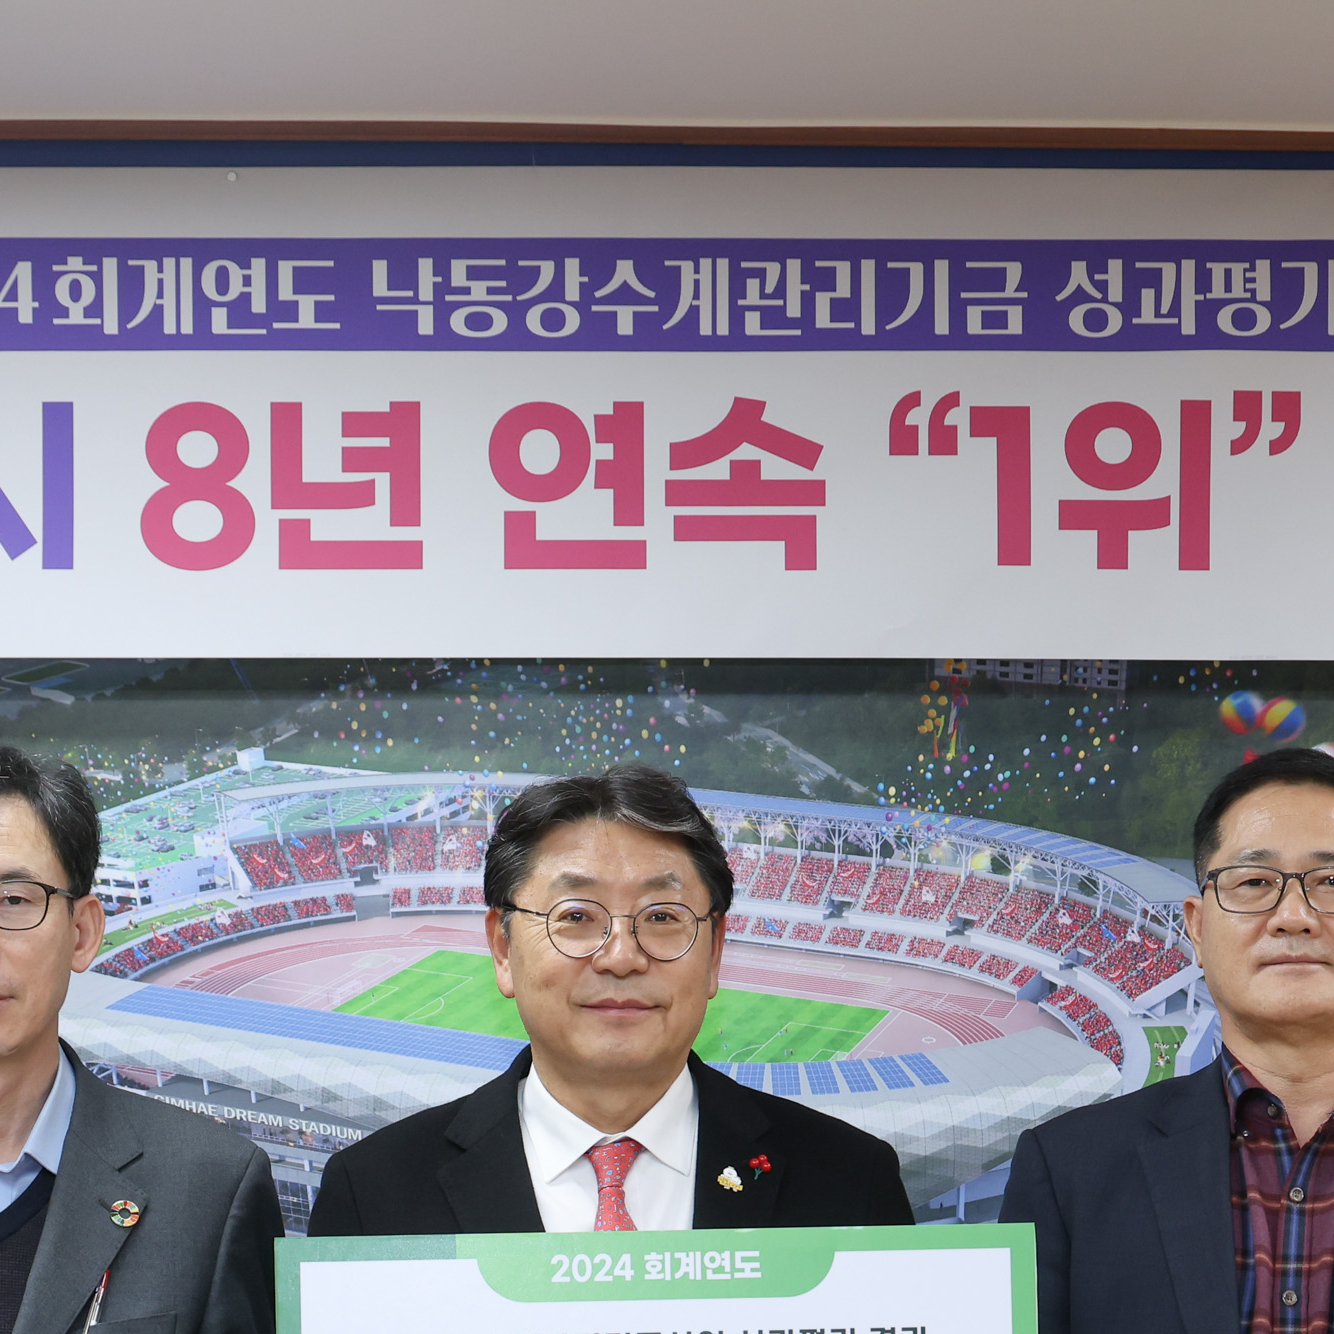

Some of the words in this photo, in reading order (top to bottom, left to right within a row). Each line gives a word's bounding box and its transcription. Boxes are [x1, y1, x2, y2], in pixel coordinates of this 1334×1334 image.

[371, 254, 1028, 339] 낙동강수계관리기금
[139, 400, 423, 571] 8년
[488, 394, 827, 571] 연속
[224, 1107, 283, 1127] DREAM
[288, 1117, 362, 1141] STADIUM
[550, 1252, 635, 1284] 2024
[644, 1250, 763, 1282] 회계연도
